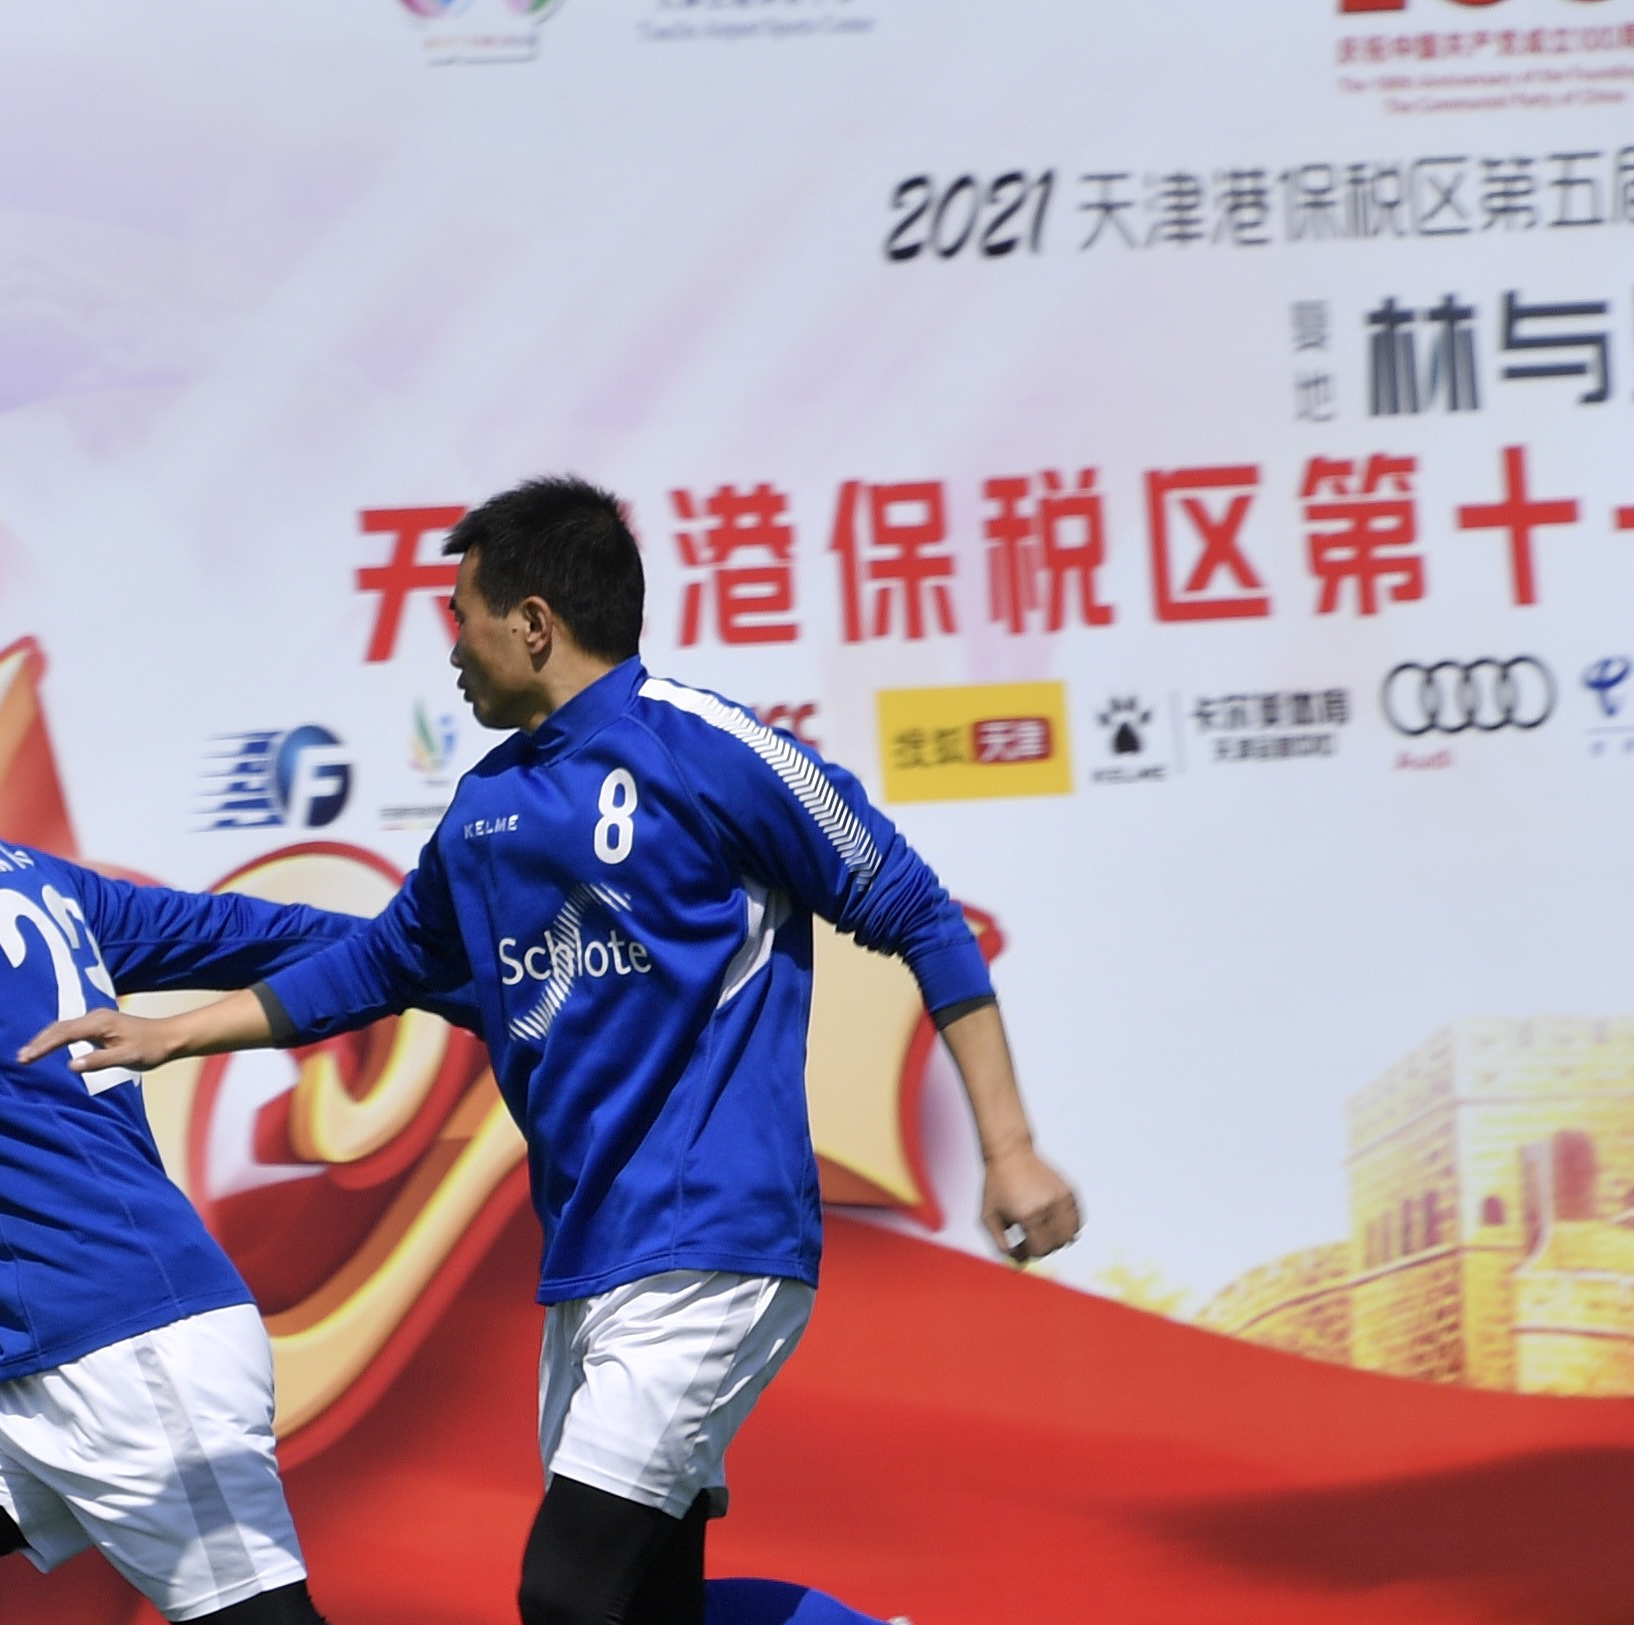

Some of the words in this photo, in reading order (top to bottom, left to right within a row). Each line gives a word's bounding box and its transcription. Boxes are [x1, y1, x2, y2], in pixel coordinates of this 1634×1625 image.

[883, 166, 1058, 264] 2021
[354, 442, 1634, 664] 天港保税区第十
[463, 813, 520, 840] KELME
[594, 767, 638, 865] 8
[498, 929, 653, 986] Schlote
